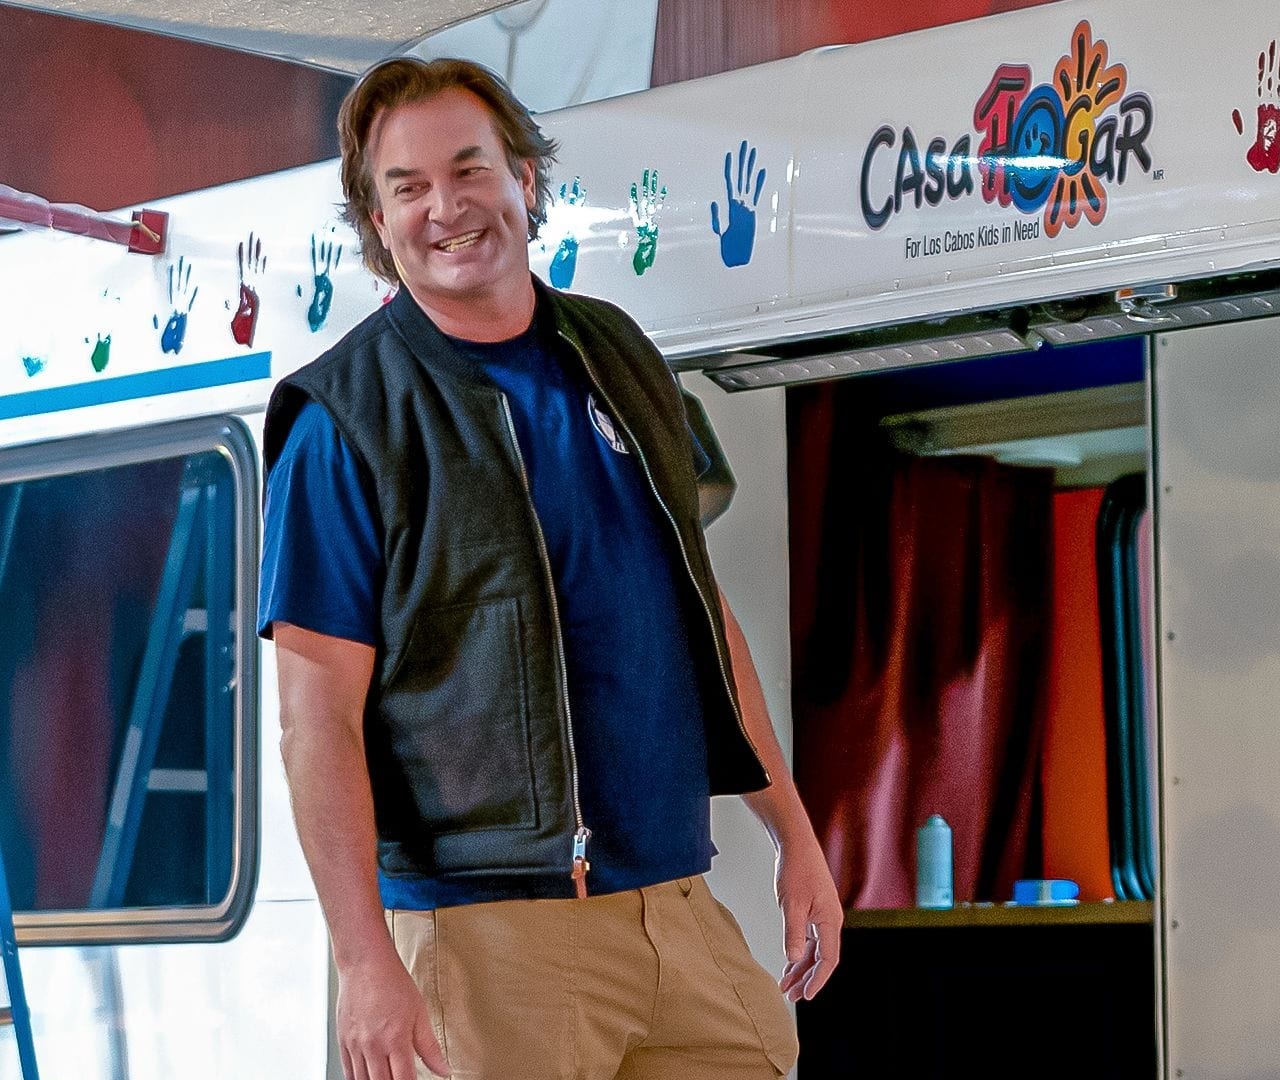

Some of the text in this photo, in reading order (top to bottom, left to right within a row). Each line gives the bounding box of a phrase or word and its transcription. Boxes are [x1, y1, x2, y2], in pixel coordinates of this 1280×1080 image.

[905, 217, 1040, 259] For Los Cabos Kids in Need
